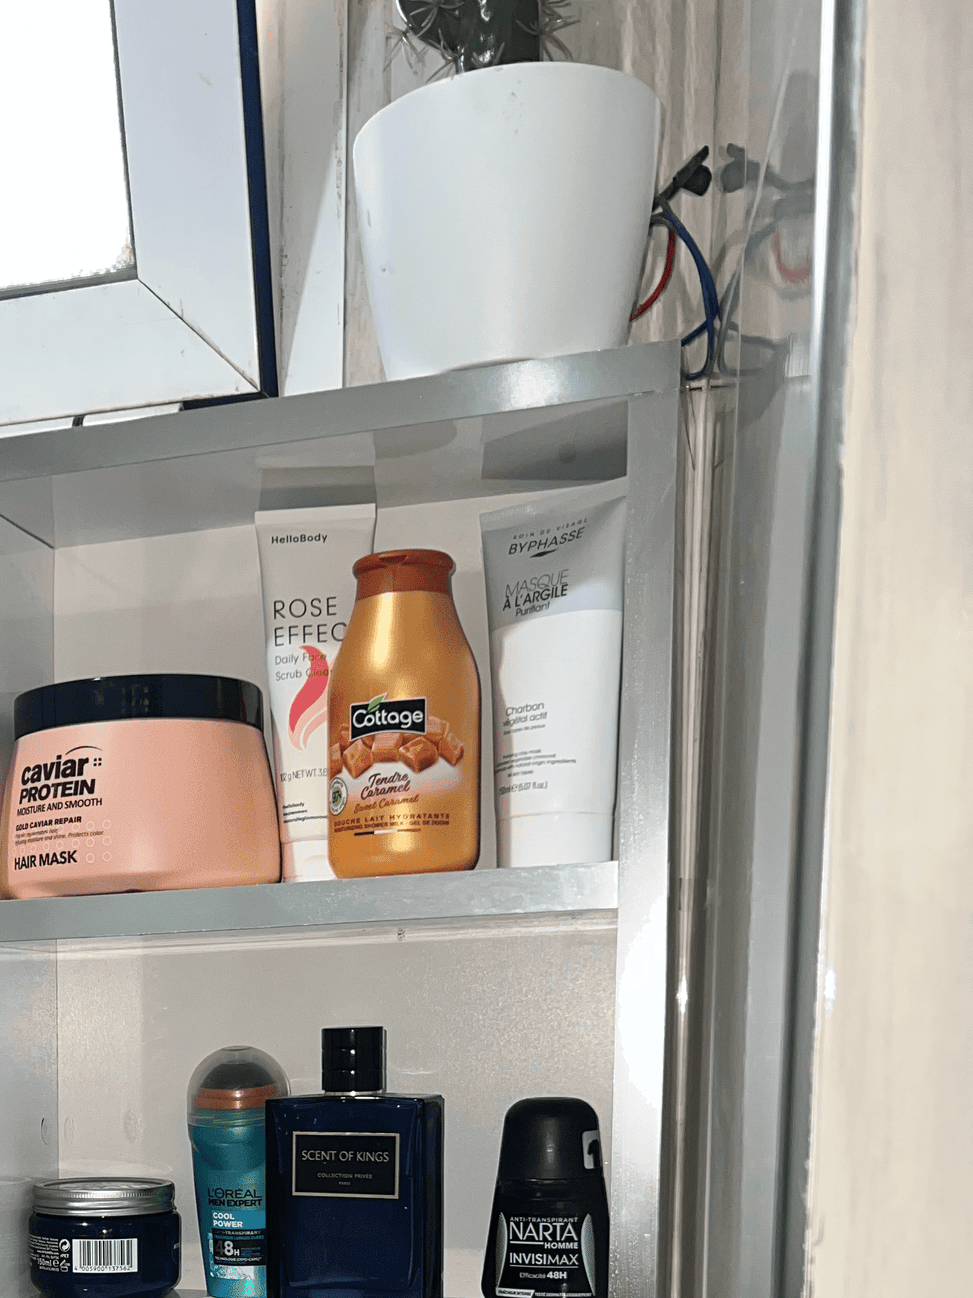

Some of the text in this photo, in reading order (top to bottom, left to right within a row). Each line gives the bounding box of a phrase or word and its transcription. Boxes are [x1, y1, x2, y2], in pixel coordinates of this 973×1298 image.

[271, 533, 328, 544] HelloBody
[508, 526, 586, 555] BYPHASSE
[505, 568, 569, 598] MASQUE
[514, 583, 569, 608] L'ARGILE
[273, 596, 337, 620] ROSE
[515, 601, 550, 617] Purifiant
[274, 622, 348, 647] EFFEC
[275, 653, 299, 666] Daily
[276, 669, 302, 681] Scrub
[505, 702, 545, 716] Charbon
[529, 711, 547, 721] actif
[352, 709, 424, 728] Cottage
[21, 754, 89, 786] caviar
[368, 771, 409, 788] Tendre
[19, 778, 96, 805] PROTEIN
[360, 780, 411, 800] Caramel
[16, 798, 103, 816] MOISTURE AND SMOOTH
[378, 794, 420, 809] Caramel
[16, 816, 82, 831] GOLD CAVIAR REPAIR
[333, 813, 450, 827] DOUCHE LAIT HYDRATANTE
[14, 850, 78, 870] HAIR MASK
[301, 1150, 389, 1162] SCENT OF KINGS
[208, 1187, 263, 1198] L'ORÉAL
[208, 1198, 263, 1207] MEN EXPERT
[212, 1212, 235, 1220] COOL
[212, 1220, 243, 1228] POWER
[509, 1221, 579, 1241] NARTA
[509, 1252, 579, 1265] INVISIMAX
[546, 1271, 567, 1279] 48H
